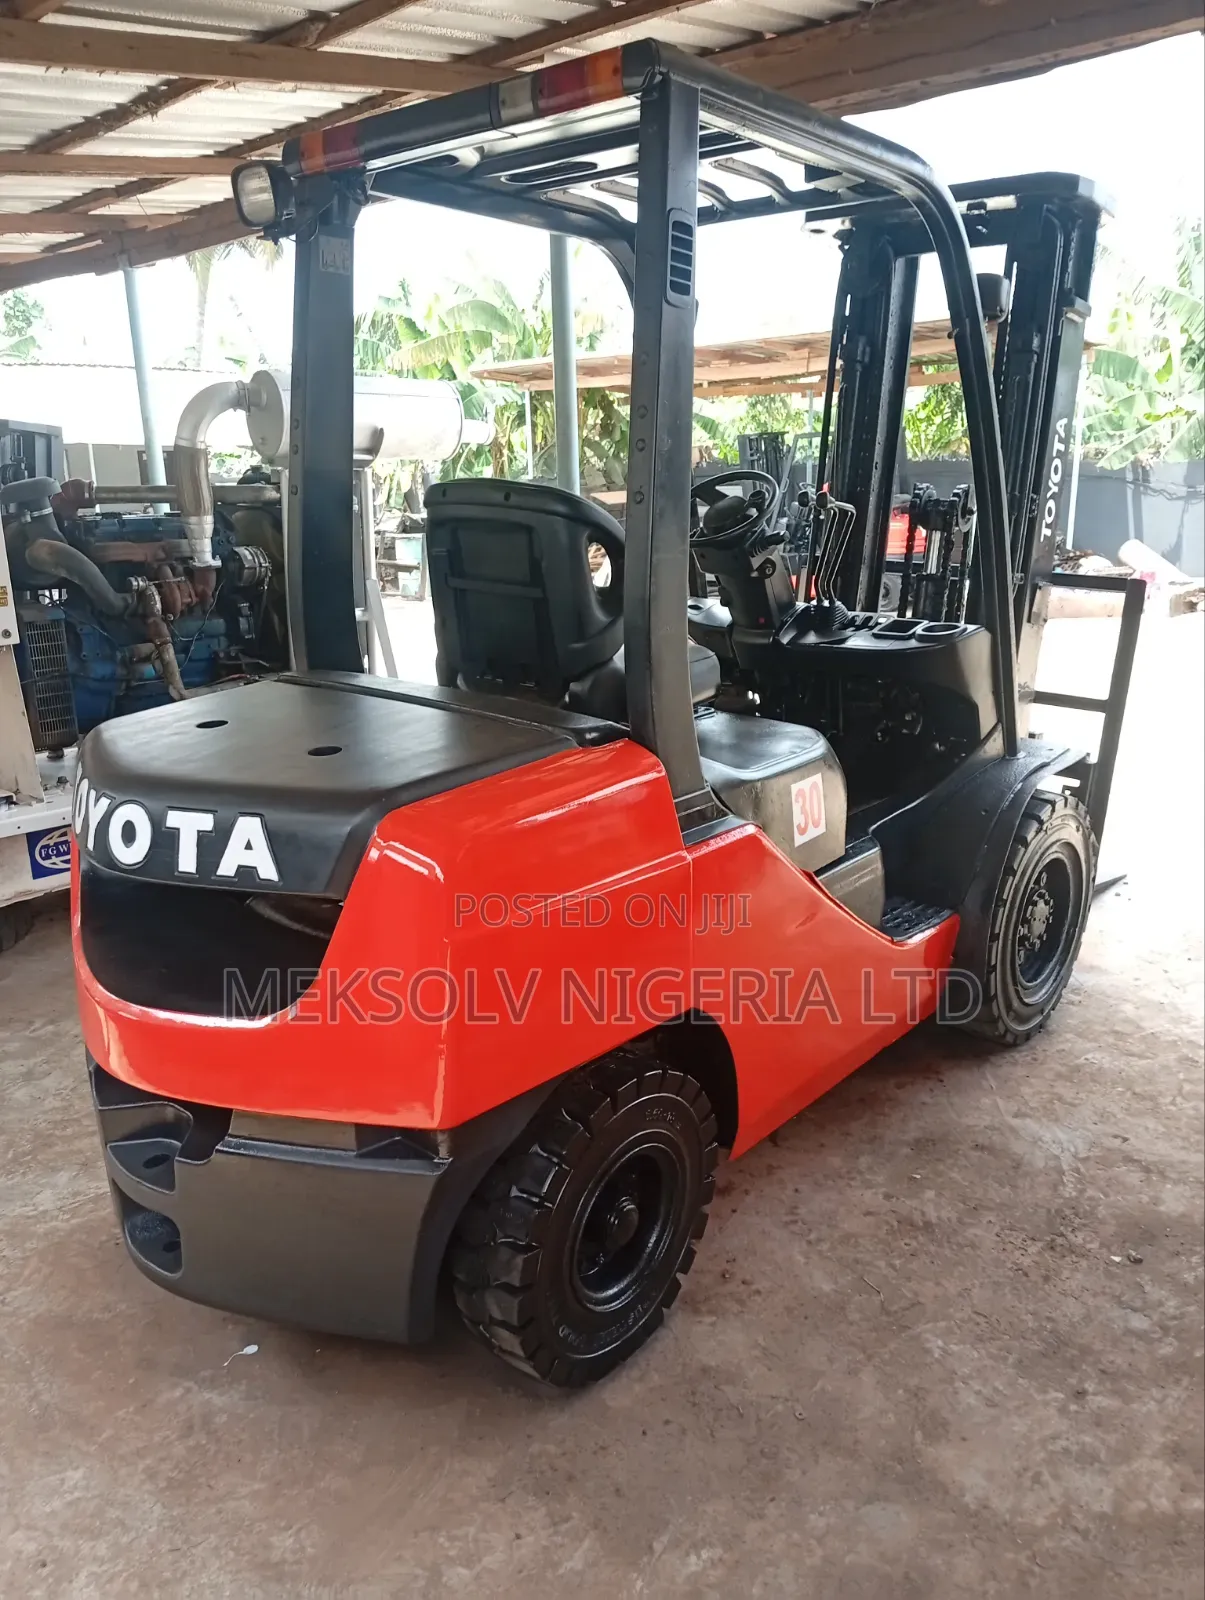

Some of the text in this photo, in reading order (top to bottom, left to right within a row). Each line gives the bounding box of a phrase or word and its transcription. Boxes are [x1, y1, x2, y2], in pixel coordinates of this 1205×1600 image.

[1040, 417, 1068, 542] TOYOTA
[73, 761, 280, 882] OYOTA
[794, 781, 822, 836] 30
